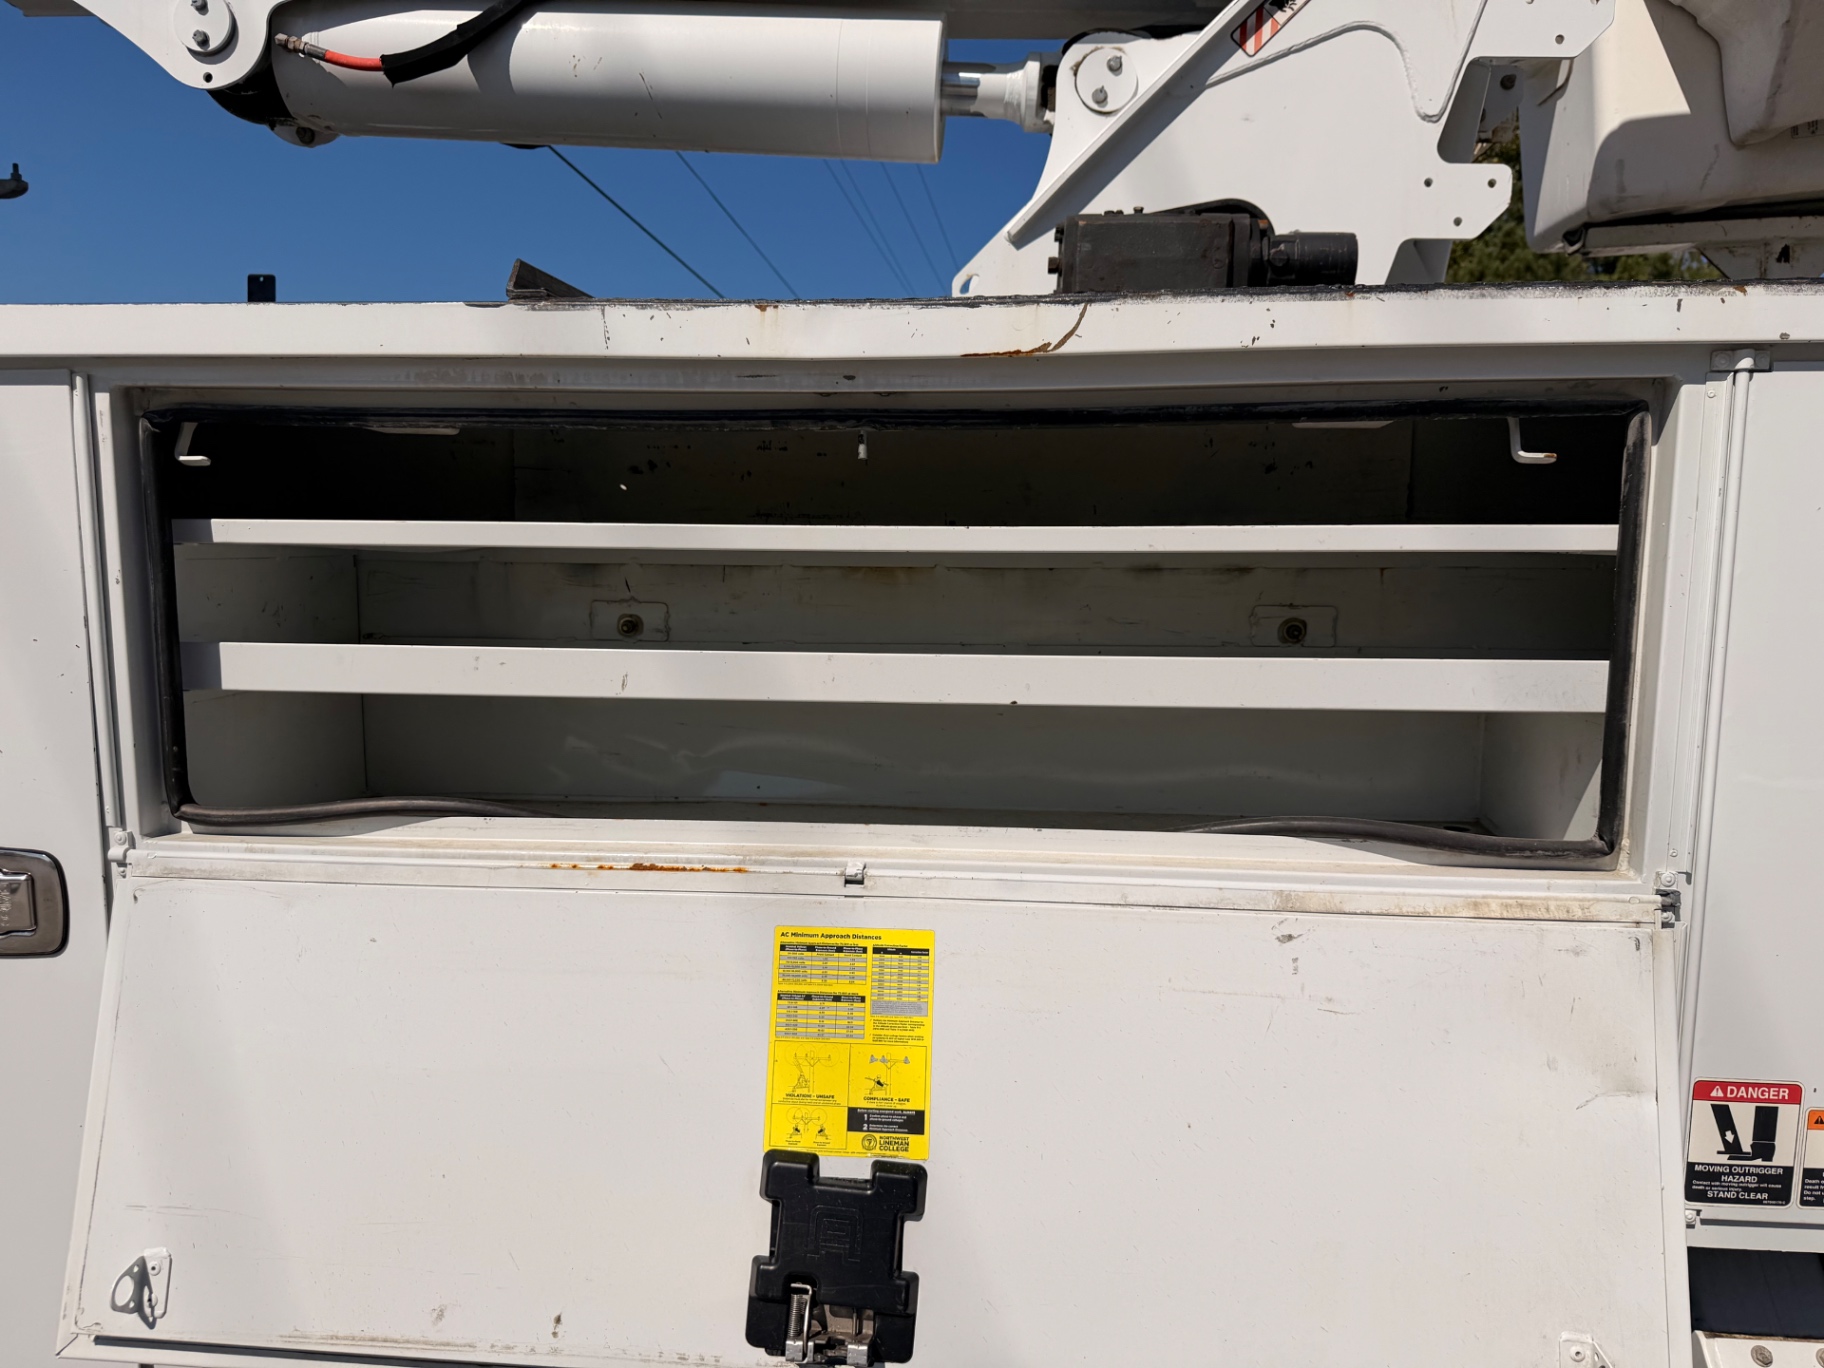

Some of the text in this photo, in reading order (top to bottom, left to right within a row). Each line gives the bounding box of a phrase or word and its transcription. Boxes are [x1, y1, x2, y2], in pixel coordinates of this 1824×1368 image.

[791, 931, 820, 939] Minimum
[820, 932, 851, 940] Approach
[851, 933, 882, 941] Distances
[1726, 1085, 1789, 1100] DANGER
[863, 1113, 868, 1121] 1
[862, 1123, 868, 1131] 2
[879, 1139, 910, 1147] LINEMAN
[1694, 1164, 1784, 1175] MOVING OUTRIGGER
[1721, 1174, 1758, 1183] HAZARD
[1706, 1190, 1769, 1200] STAND CLEAR
